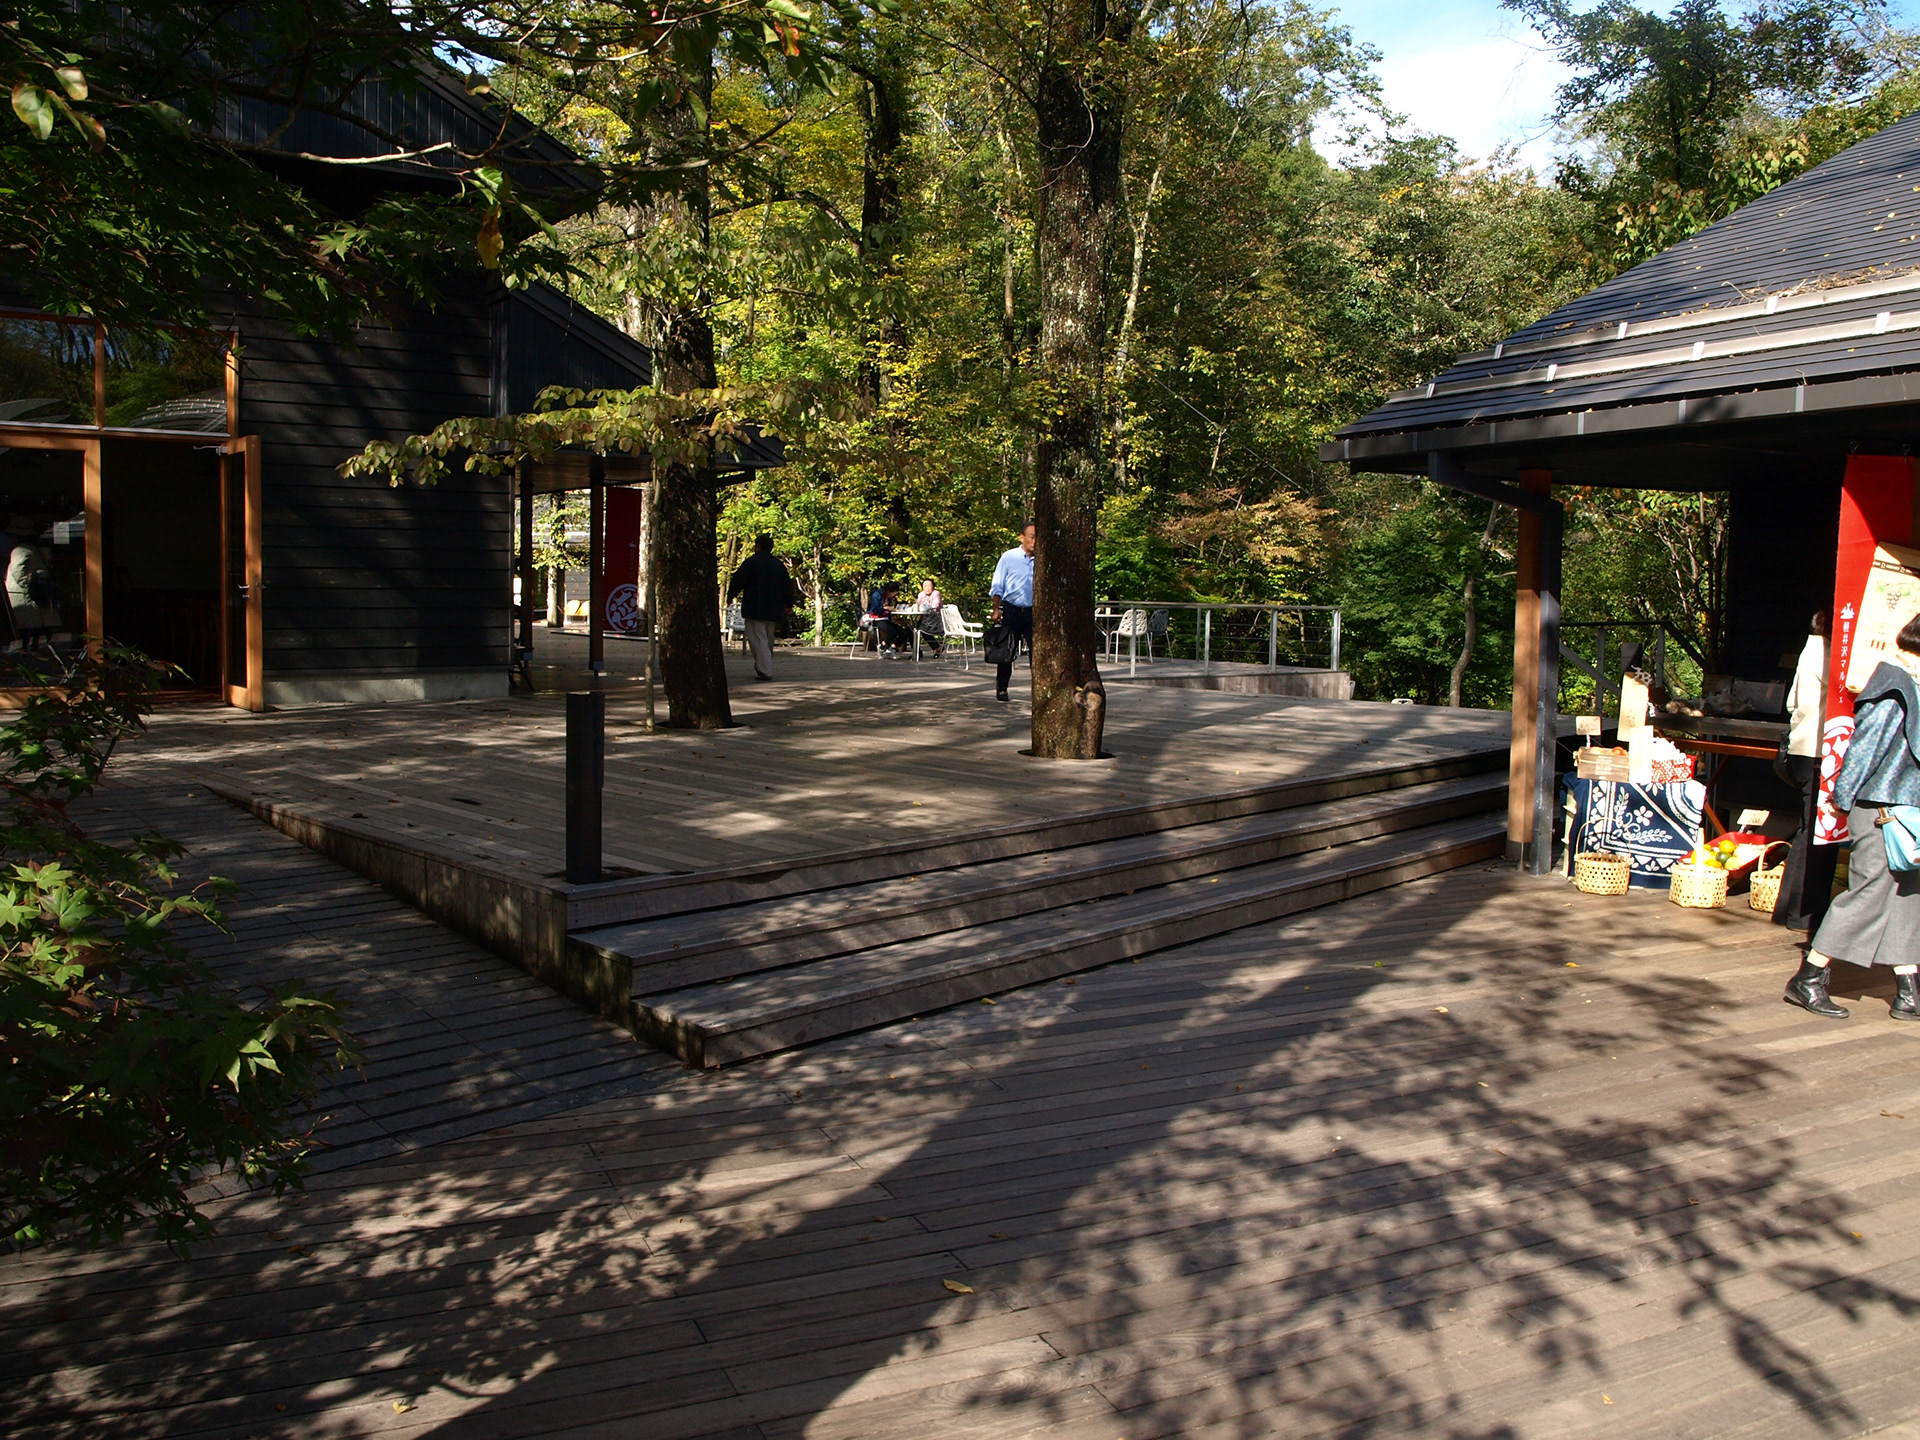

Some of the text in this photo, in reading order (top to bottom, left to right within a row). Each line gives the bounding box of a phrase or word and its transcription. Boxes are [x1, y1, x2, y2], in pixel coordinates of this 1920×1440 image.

[1839, 621, 1850, 704] 軽井沢マルシェ
